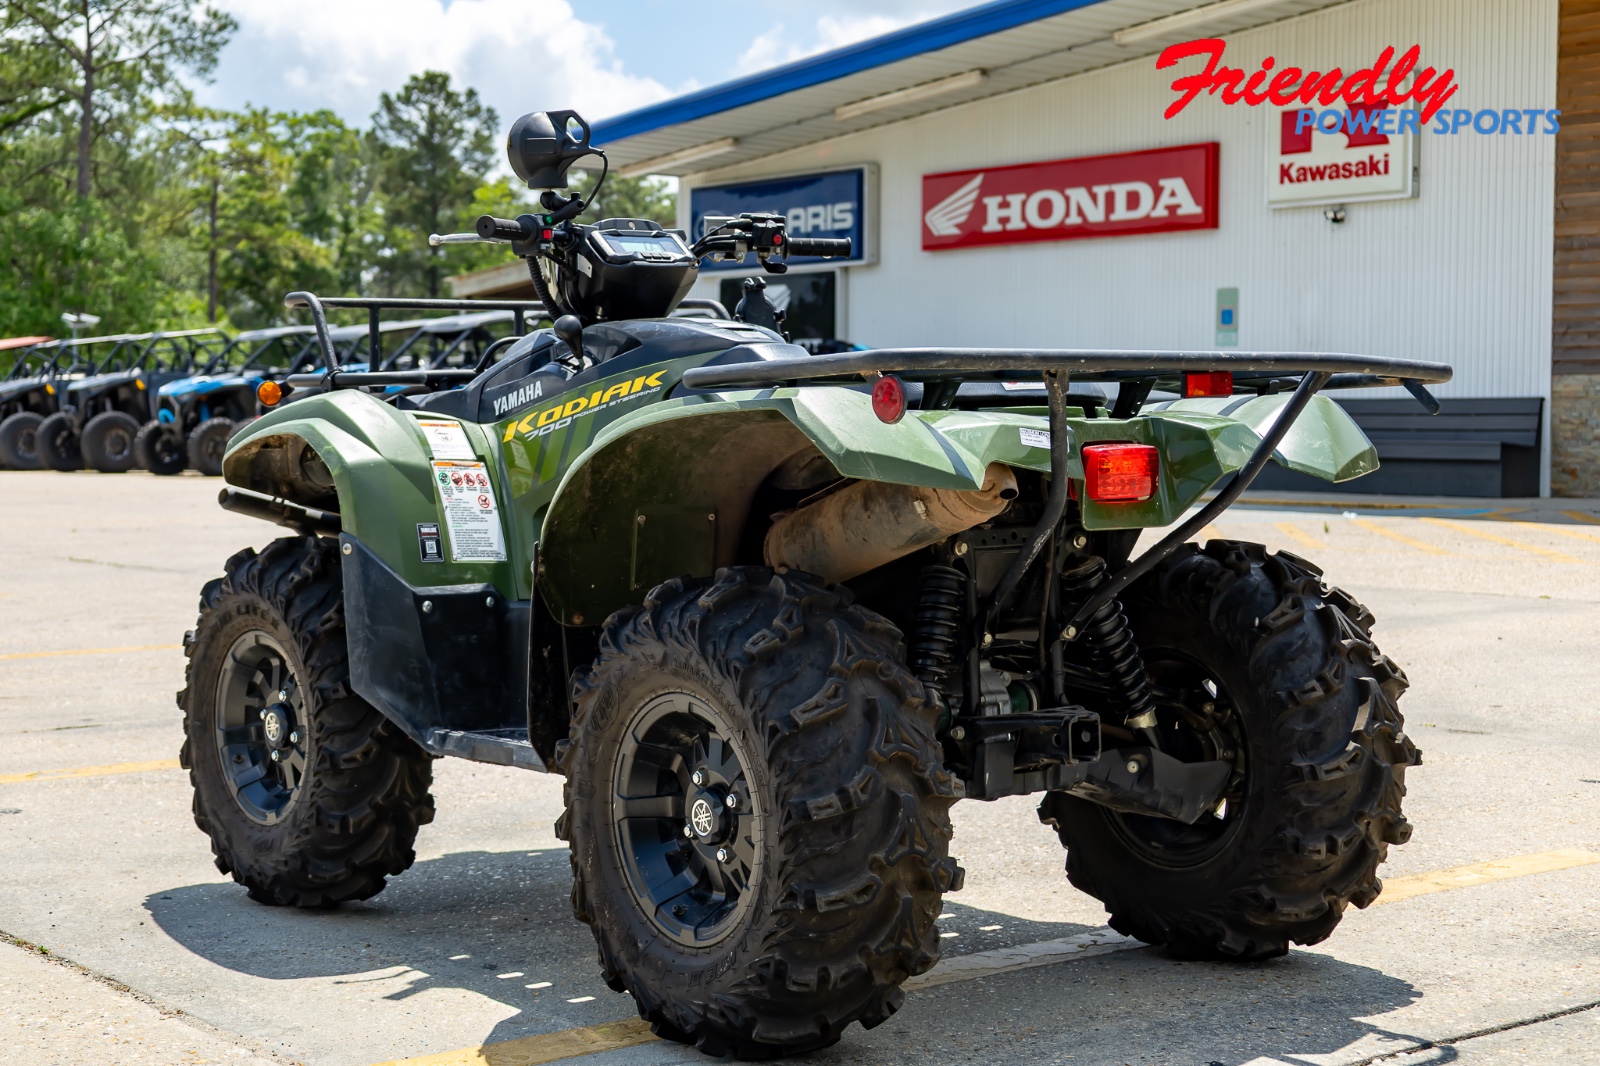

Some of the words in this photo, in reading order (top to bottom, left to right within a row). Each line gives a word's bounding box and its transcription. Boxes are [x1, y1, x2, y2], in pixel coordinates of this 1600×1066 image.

[1279, 153, 1390, 185] Kawasaki
[982, 177, 1202, 232] HONDA
[493, 380, 543, 416] YAMAHA
[503, 369, 668, 443] KODIAK
[524, 416, 572, 442] 700
[573, 403, 607, 419] POWER
[609, 386, 661, 406] STEERING
